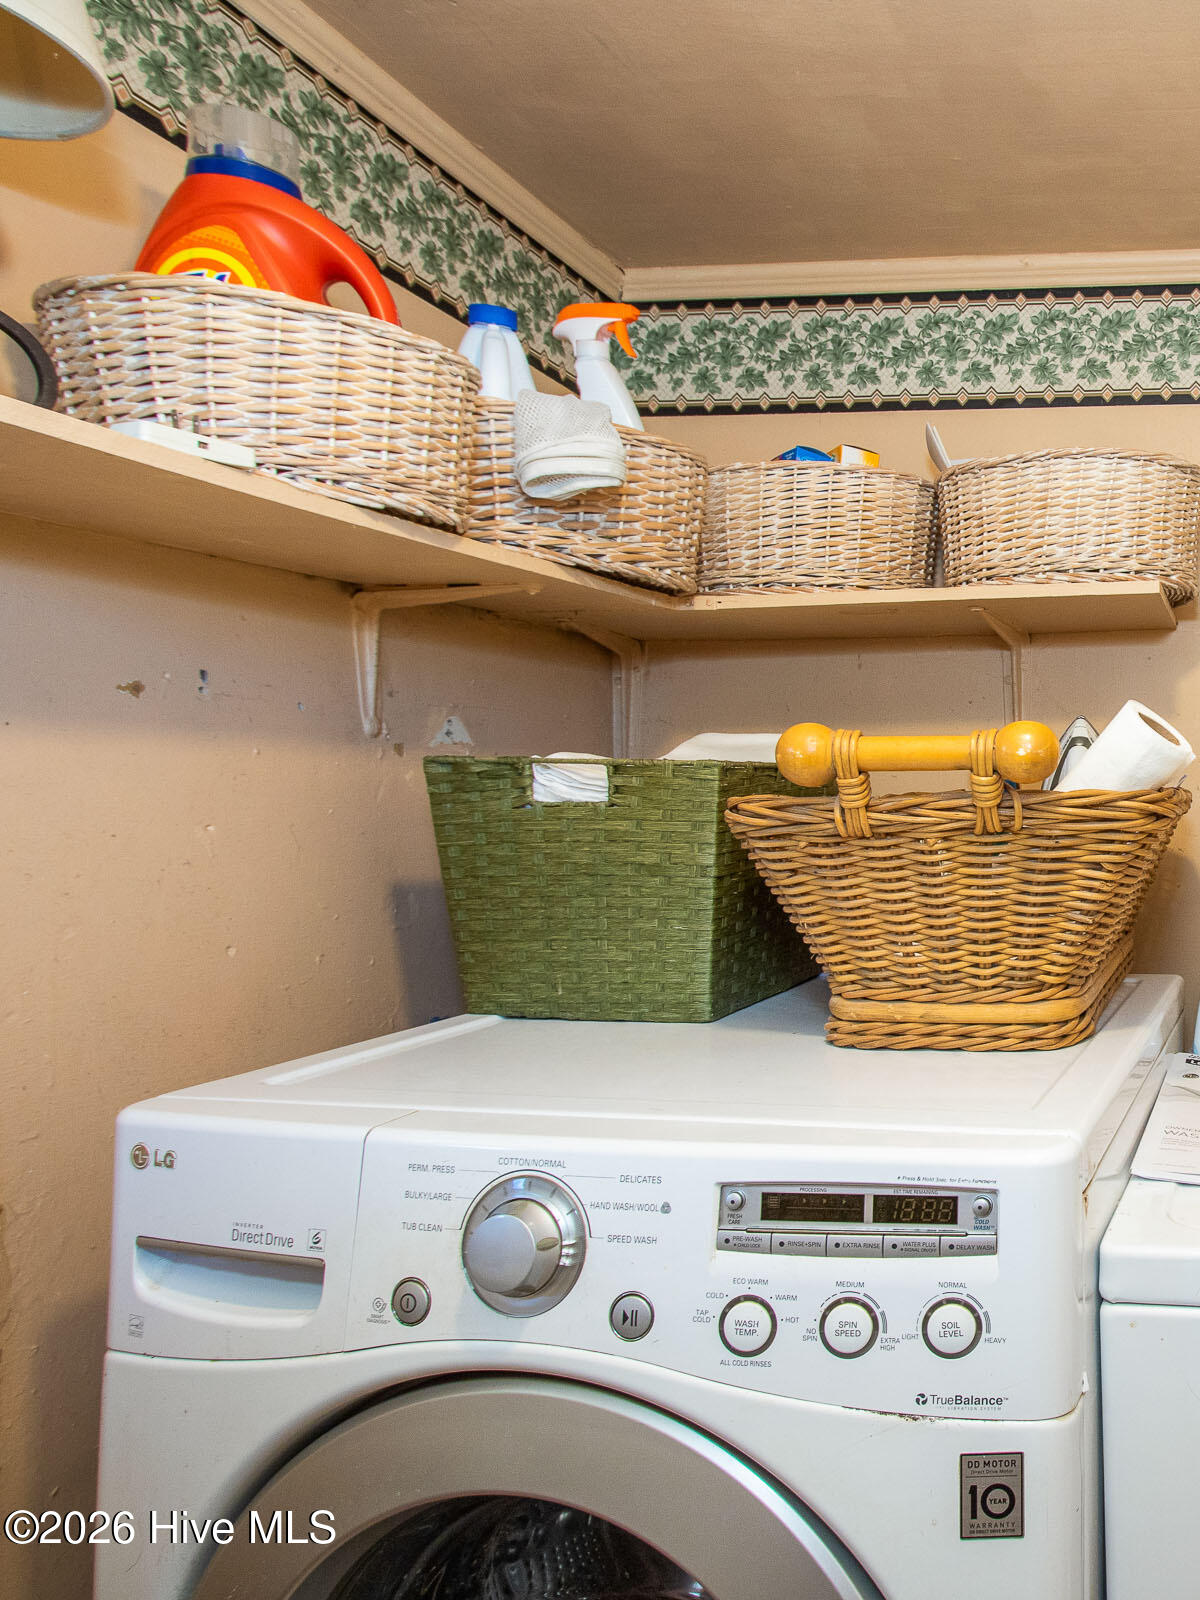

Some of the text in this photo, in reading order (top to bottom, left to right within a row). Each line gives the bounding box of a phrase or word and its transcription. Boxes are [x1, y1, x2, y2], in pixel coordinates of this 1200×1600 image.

[154, 1150, 177, 1169] LG
[498, 1157, 567, 1168] COTTON/NORMAL
[432, 1165, 456, 1174] PRESS
[620, 1174, 662, 1184] DELICATES
[404, 1190, 453, 1201] BULKY/LARGE
[590, 1201, 659, 1212] HAND WASH/WOOL
[233, 1221, 264, 1229] INVERTER
[402, 1221, 442, 1232] TUB CLEAN
[232, 1228, 294, 1248] Direct Drive
[608, 1234, 658, 1245] SPEED WASH
[938, 1281, 967, 1289] NORMAL
[734, 1320, 760, 1328] WASH
[941, 1321, 960, 1329] SOIL
[734, 1328, 759, 1336] TEMP.
[834, 1329, 862, 1337] SPEED
[938, 1330, 964, 1338] LEVEL
[749, 1360, 772, 1368] RINSES
[967, 1460, 1017, 1468] DD MOTOR
[968, 1483, 1016, 1520] 10
